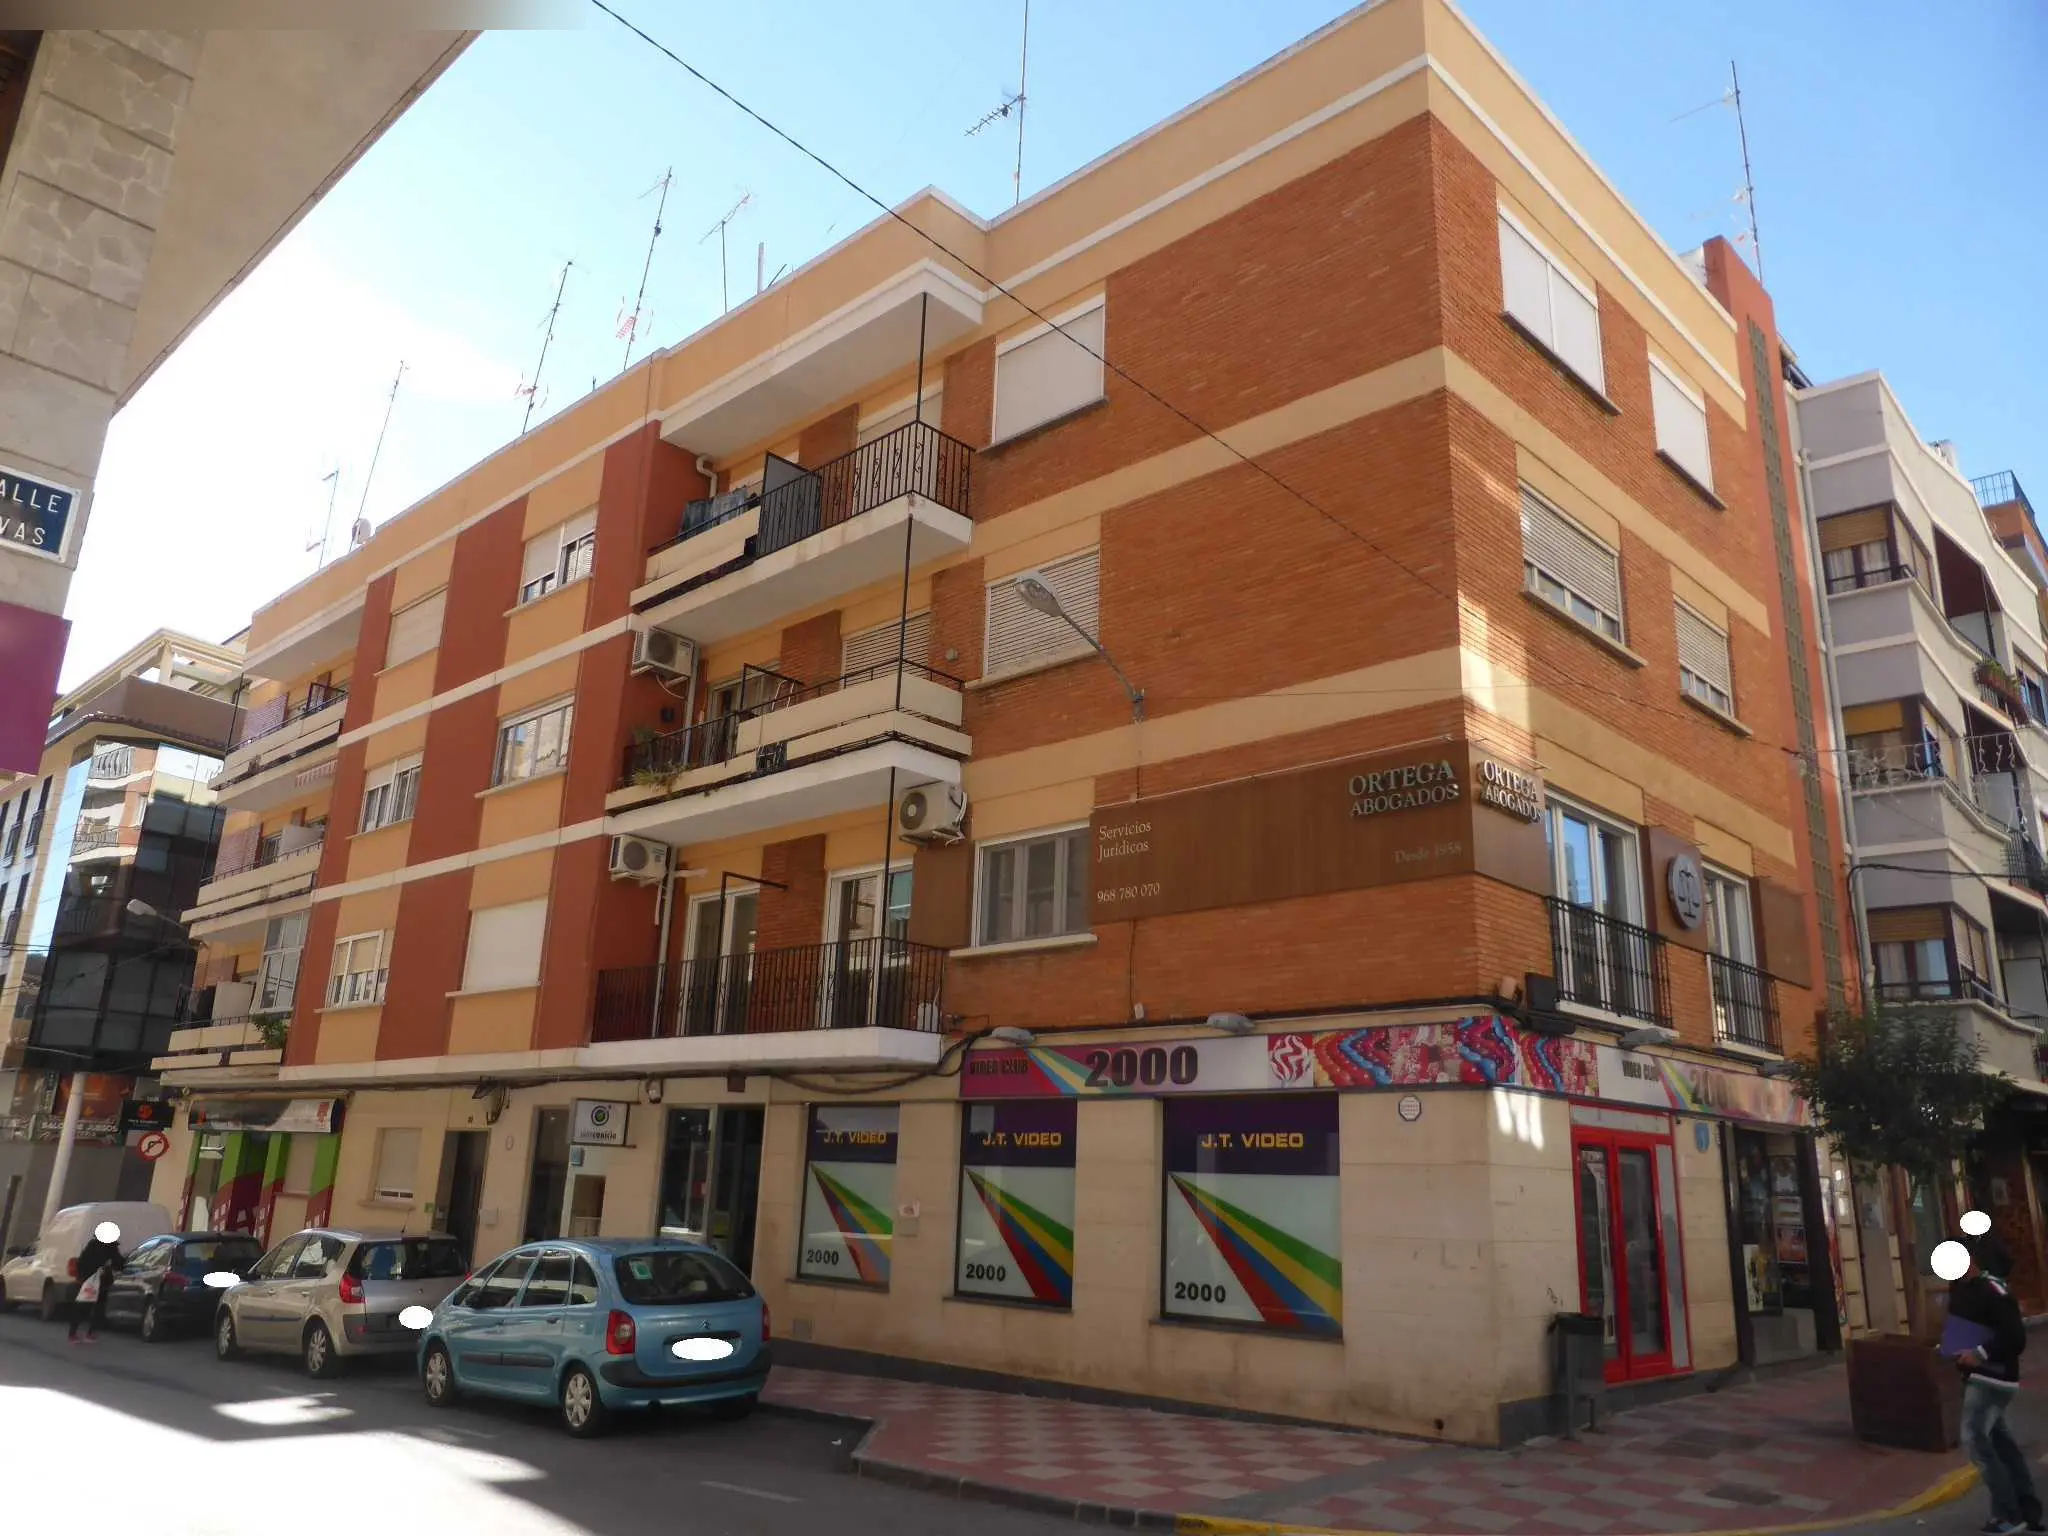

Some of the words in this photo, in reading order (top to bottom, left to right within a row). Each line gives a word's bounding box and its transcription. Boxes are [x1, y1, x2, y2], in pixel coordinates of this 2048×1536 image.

[1349, 760, 1456, 796] ORTEGA
[1483, 759, 1537, 799] ORTEGA
[1351, 784, 1460, 816] ABOGADOS
[1485, 784, 1542, 822] ABOGADOS
[1099, 820, 1152, 840] Servicios
[1097, 888, 1116, 903] 968
[1119, 885, 1138, 902] 780
[1140, 881, 1160, 897] 070
[970, 1060, 998, 1075] VIDEO
[1084, 1045, 1199, 1087] 2000
[848, 1130, 888, 1145] VIDEO
[982, 1132, 1007, 1147] J.T.
[1013, 1132, 1062, 1146] VIDEO
[1200, 1133, 1233, 1149] J.T.
[1241, 1132, 1305, 1149] VIDEO
[806, 1250, 840, 1266] 2000
[965, 1263, 1007, 1282] 2000
[1174, 1282, 1227, 1303] 2000
